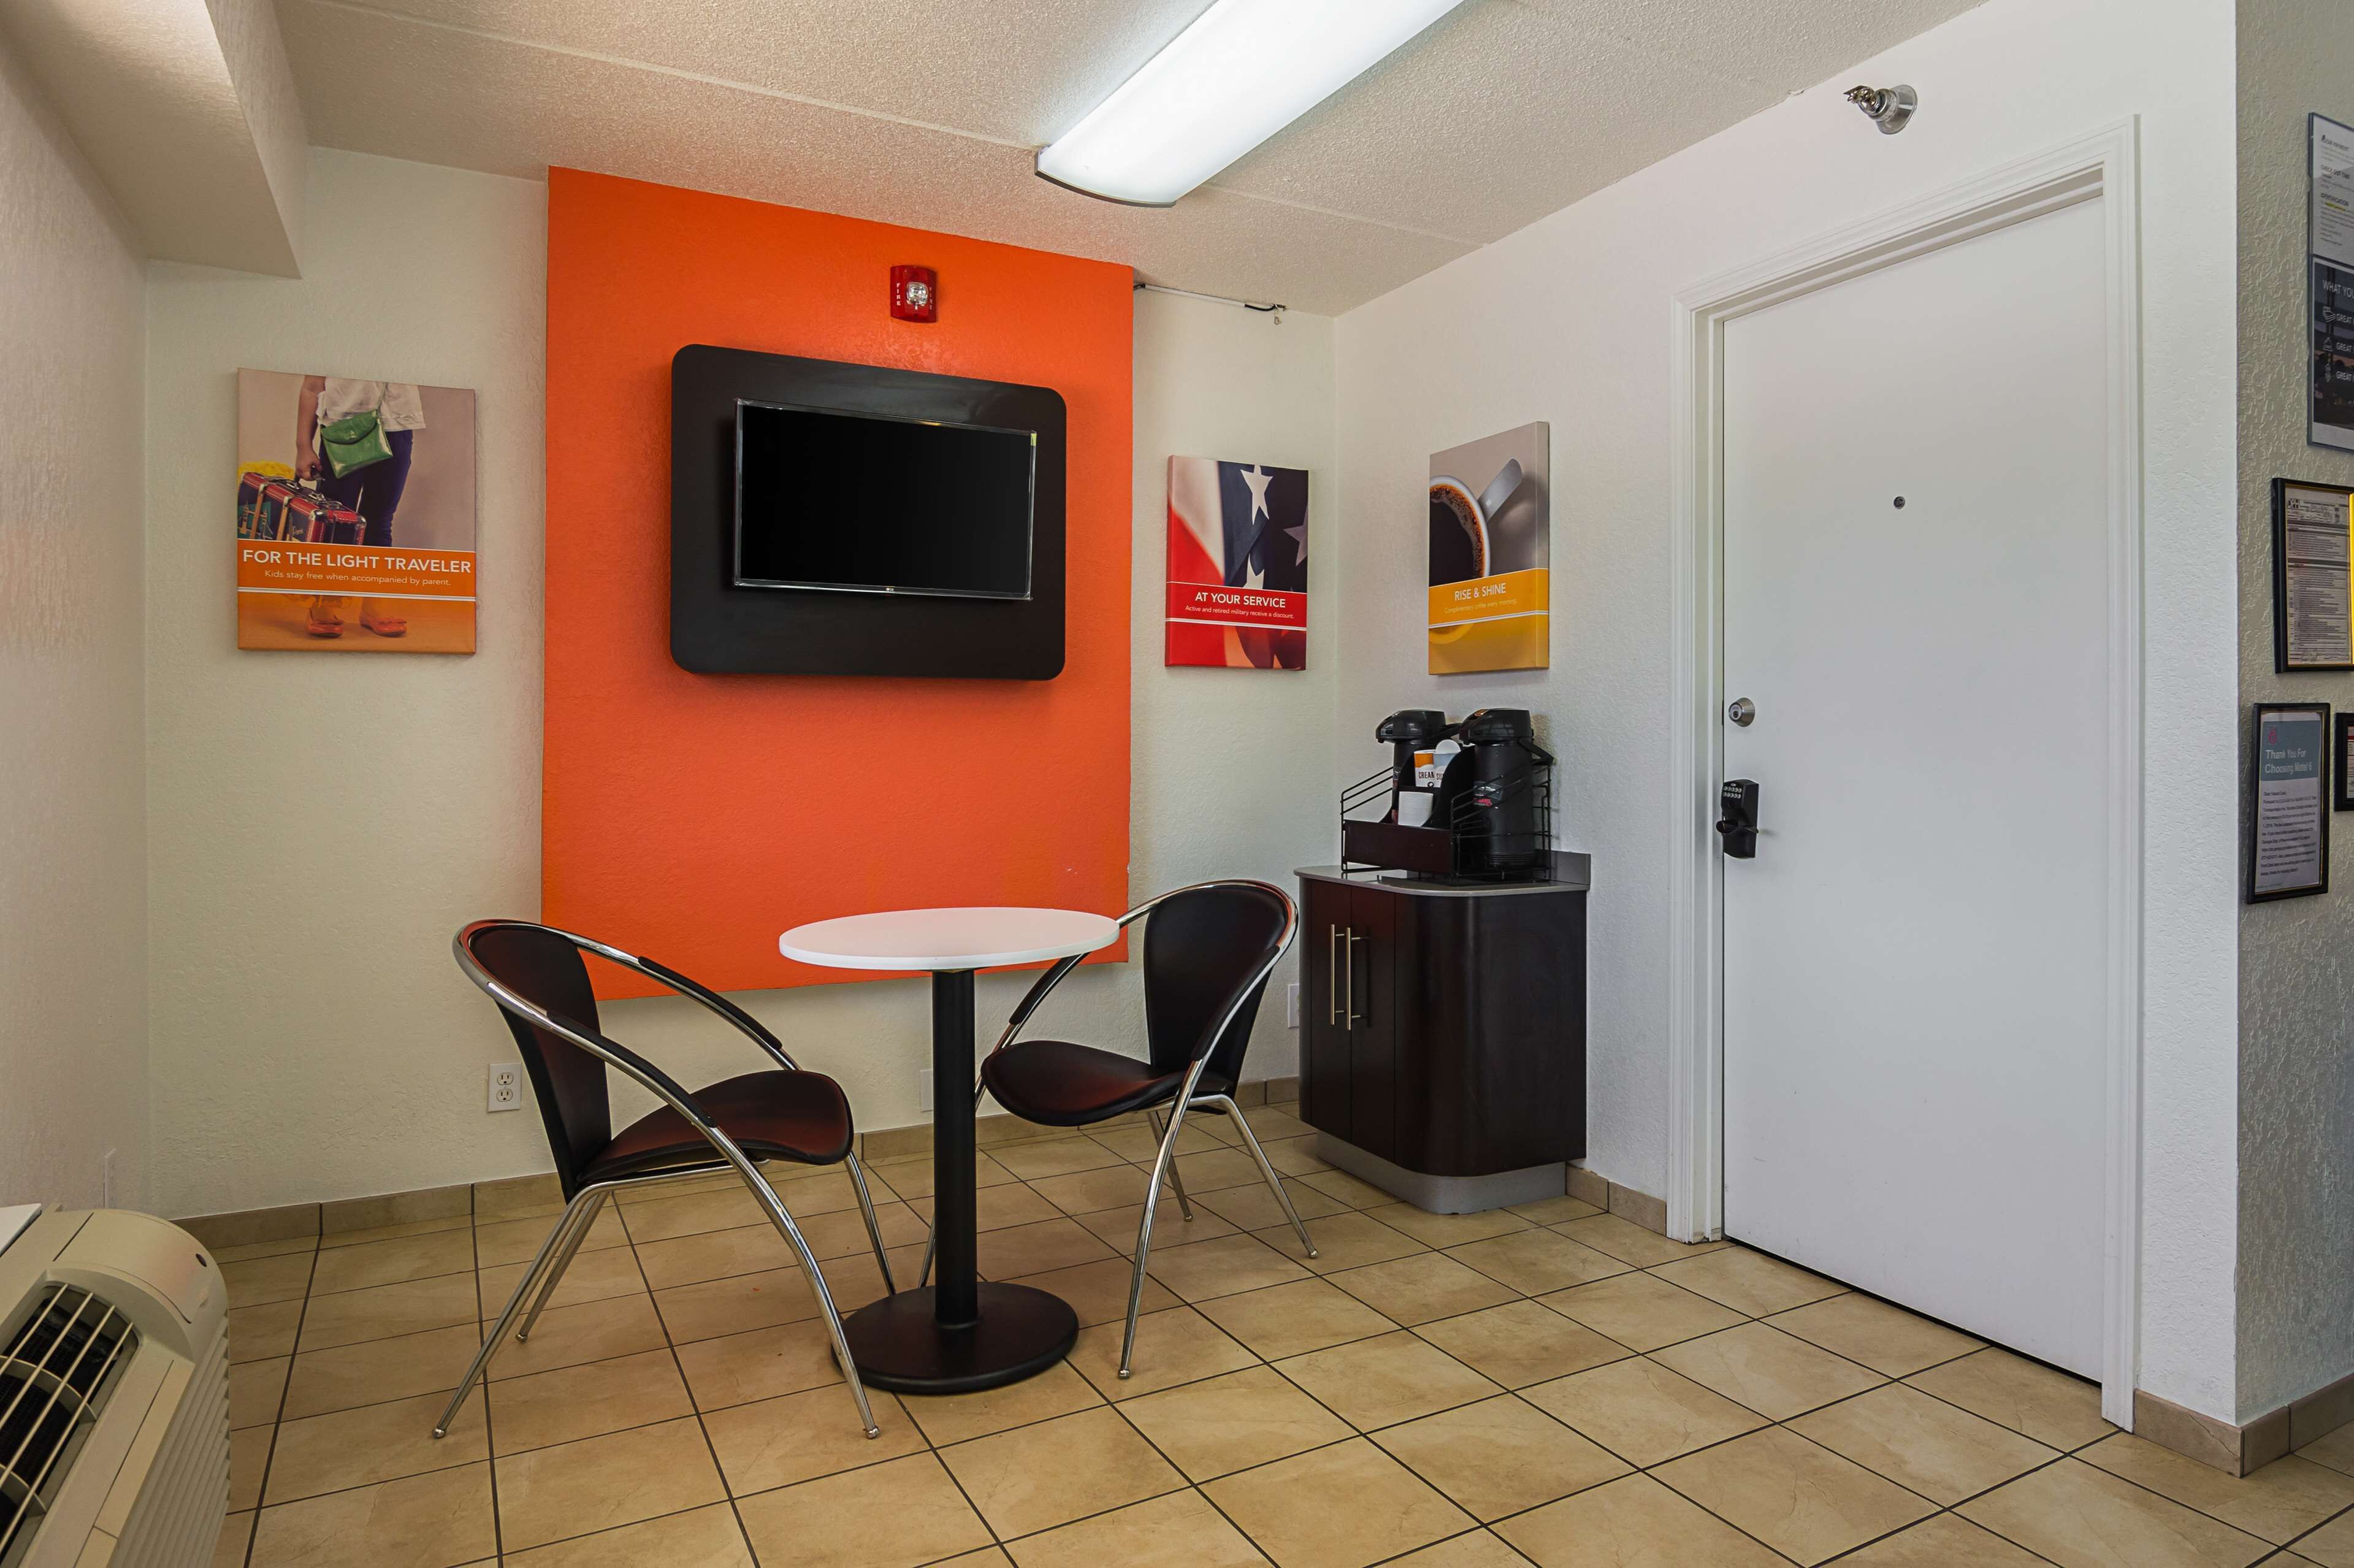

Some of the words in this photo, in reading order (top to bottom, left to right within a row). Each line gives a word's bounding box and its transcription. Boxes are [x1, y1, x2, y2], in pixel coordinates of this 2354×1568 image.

[2323, 280, 2341, 294] WHAT
[2336, 313, 2352, 324] GREAT
[2336, 342, 2352, 353] GREAT
[2336, 371, 2352, 381] GREAT
[243, 549, 281, 564] FOR
[286, 552, 322, 565] THE
[326, 554, 380, 568] LIGHT
[384, 556, 472, 573] TRAVELER
[351, 575, 408, 584] accompanied
[410, 577, 420, 586] by
[1454, 589, 1472, 601] RISE
[1473, 587, 1480, 599] &
[1481, 583, 1507, 597] SHINE
[1195, 592, 1209, 602] AT
[1211, 593, 1240, 604] YOUR
[1244, 595, 1286, 608] SERVICE
[1231, 608, 1249, 617] military
[2266, 749, 2286, 760] Thank
[2287, 749, 2296, 759] You
[2297, 748, 2306, 758] For
[2265, 763, 2294, 774] Choosing
[2309, 762, 2313, 771] 6
